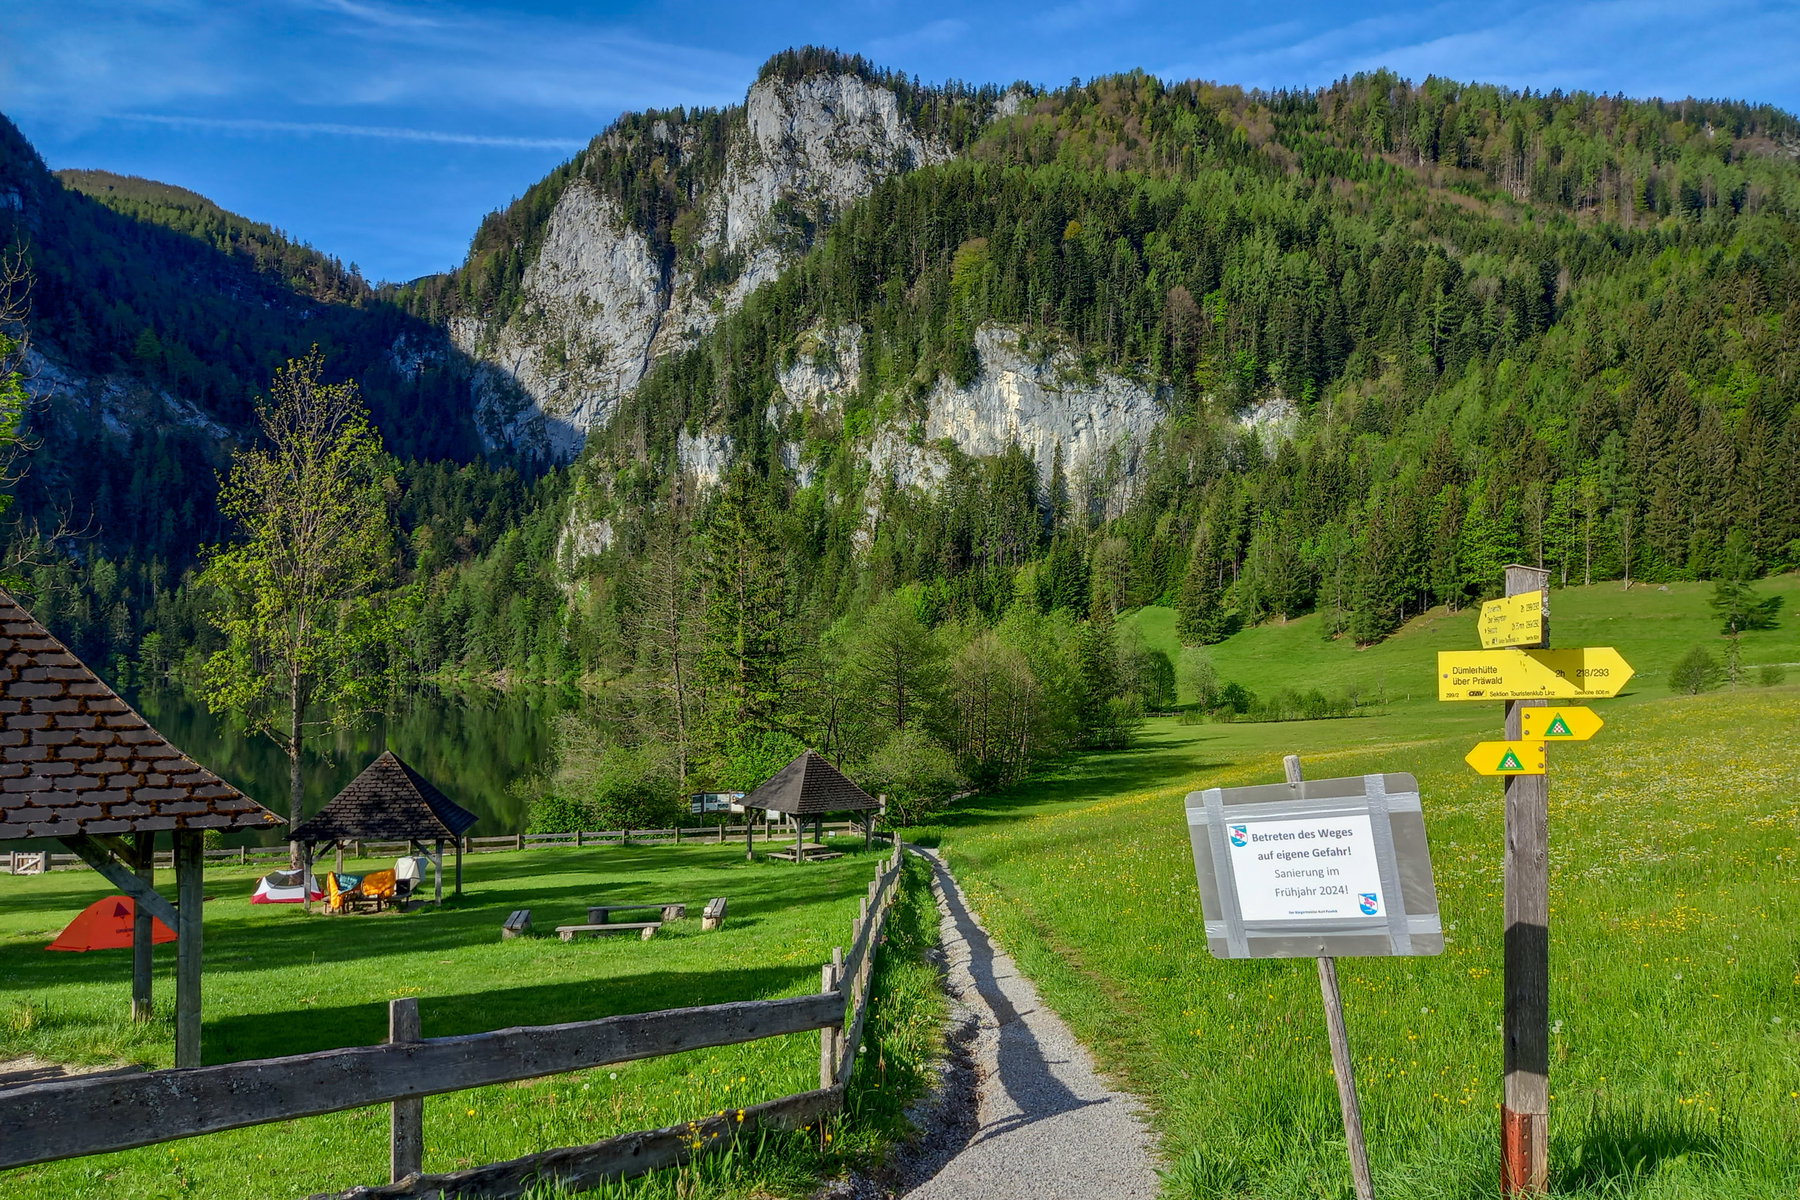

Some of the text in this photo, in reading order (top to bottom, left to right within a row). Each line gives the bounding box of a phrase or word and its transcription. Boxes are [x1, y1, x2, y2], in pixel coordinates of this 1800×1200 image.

[1452, 666, 1498, 675] Dümlerhütte
[1555, 668, 1609, 678] 2h 218/293
[1452, 676, 1503, 686] über Präwald
[1252, 828, 1354, 843] Betreten des Weges
[1257, 846, 1352, 861] auf eigene Gefahr!
[1274, 867, 1340, 879] Sanierung im
[1274, 885, 1349, 899] Frühjahr 2024!
